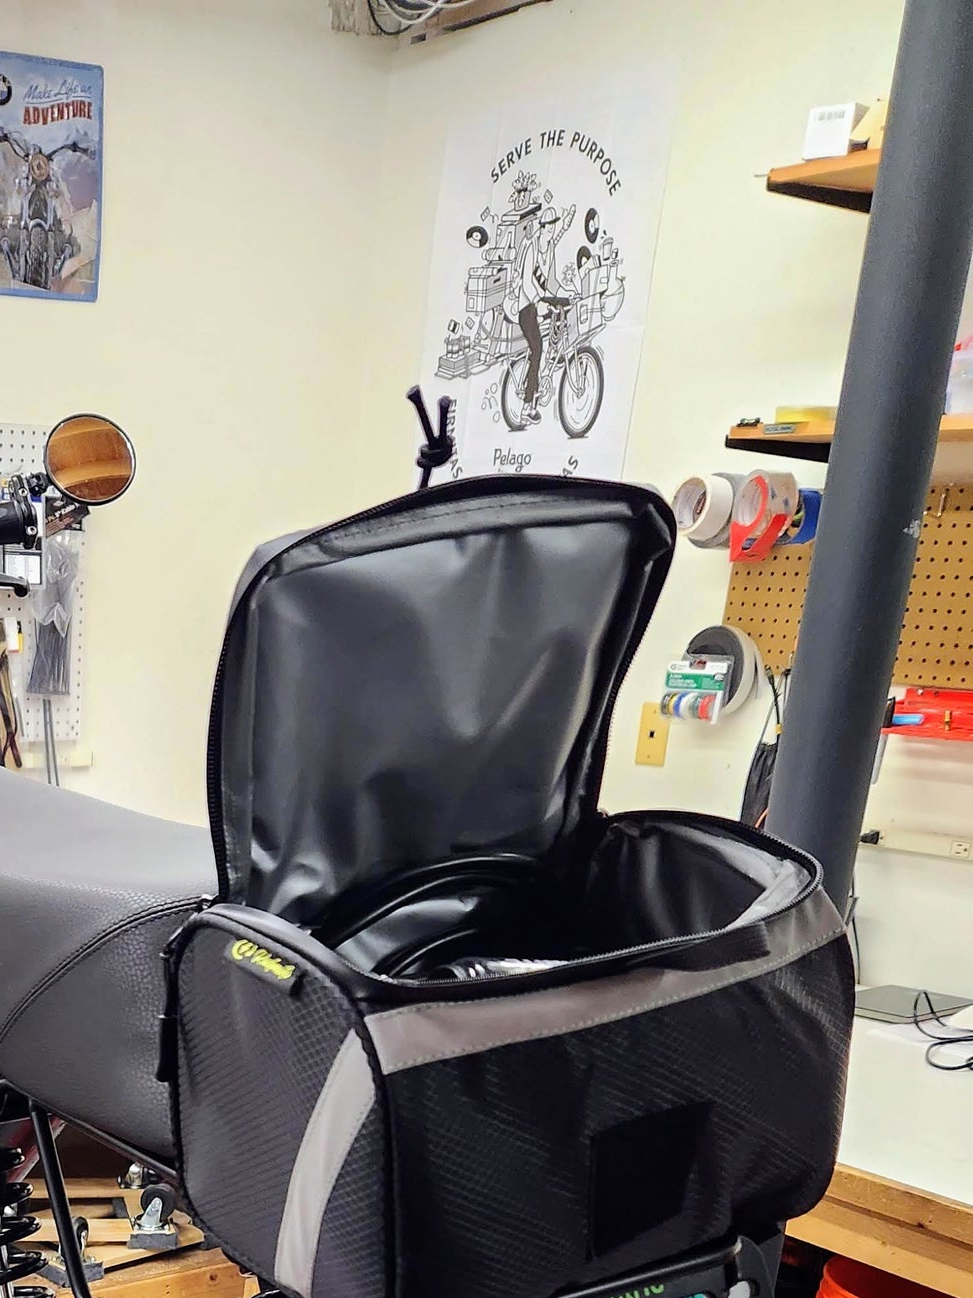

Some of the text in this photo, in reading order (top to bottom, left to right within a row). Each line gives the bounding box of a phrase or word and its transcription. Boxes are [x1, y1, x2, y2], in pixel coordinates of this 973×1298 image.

[23, 84, 52, 101] Make
[23, 100, 93, 126] ADVENTURE
[490, 129, 623, 198] SERVE THE PURPOSE
[493, 447, 533, 473] Pelago
